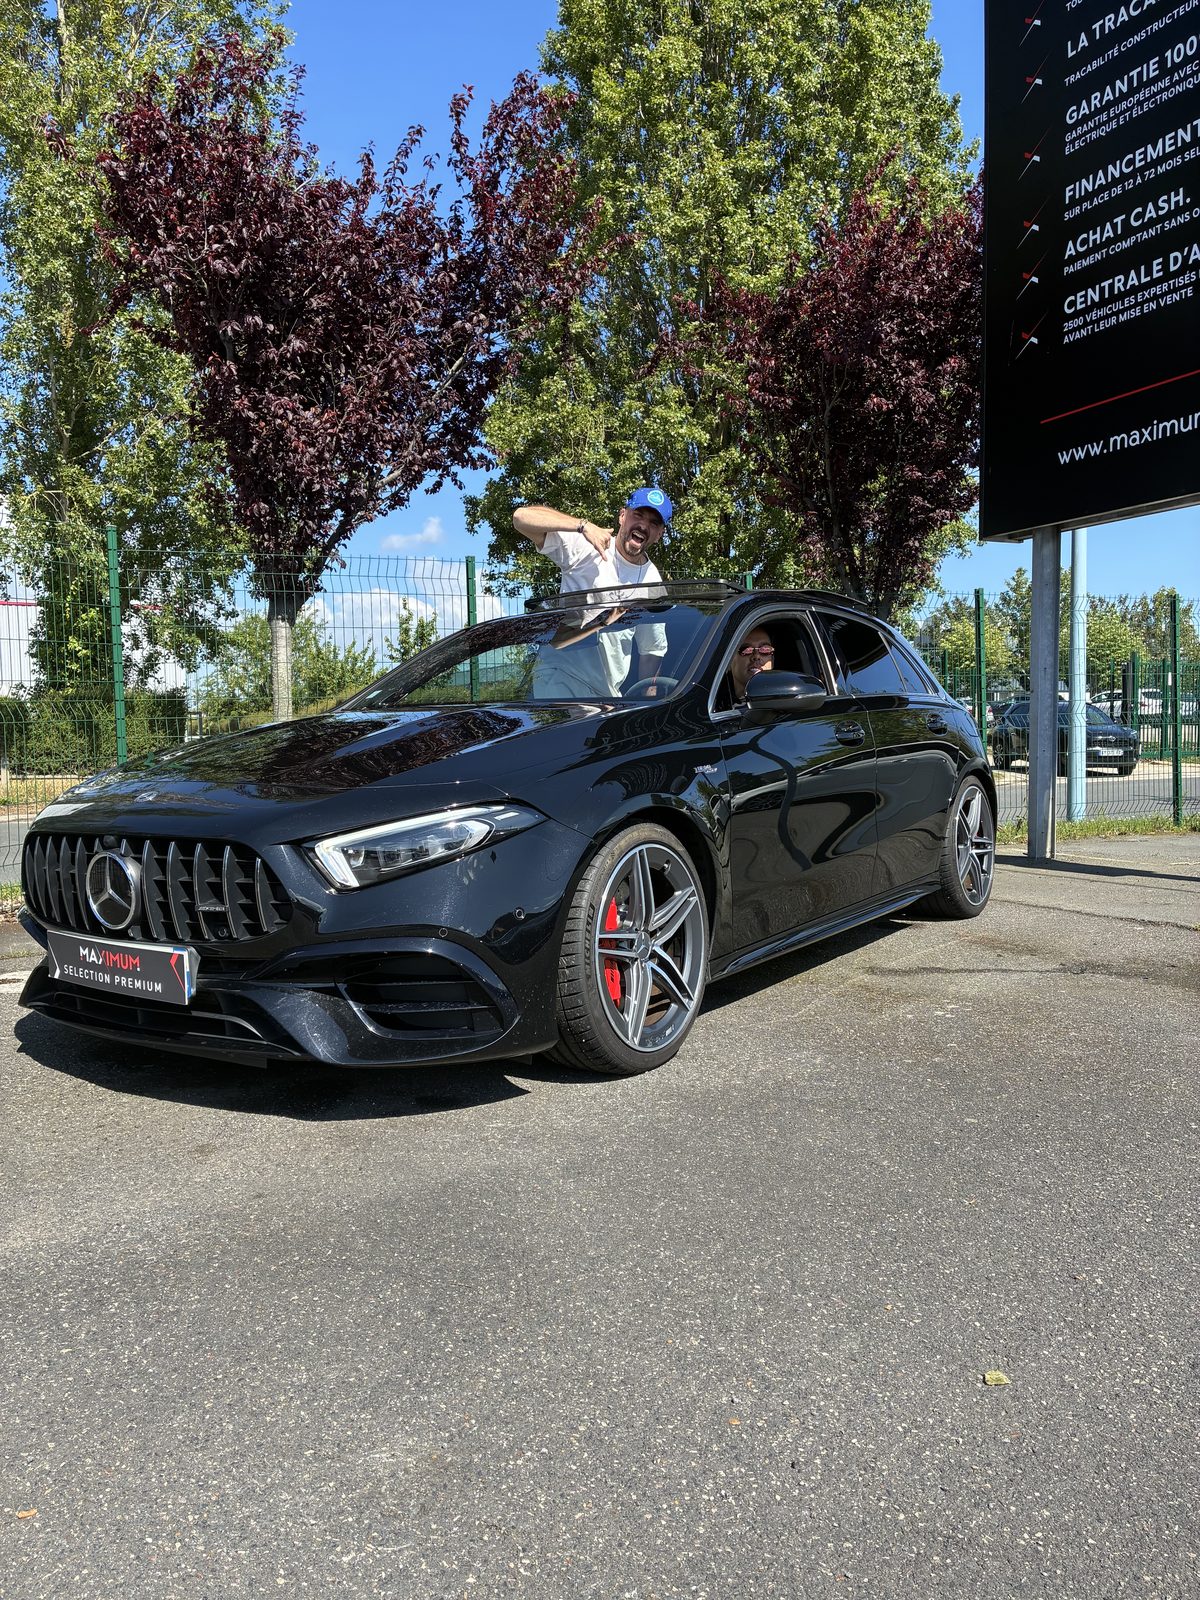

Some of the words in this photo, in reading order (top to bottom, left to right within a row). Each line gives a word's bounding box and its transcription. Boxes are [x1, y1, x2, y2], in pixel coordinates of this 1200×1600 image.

[1064, 43, 1119, 87] TRACABILITÉ
[1120, 0, 1199, 52] CONSTRUCTEUR
[1067, 31, 1089, 59] LA
[1091, 0, 1161, 40] TRACA
[1064, 110, 1108, 143] GARANTIE
[1109, 75, 1171, 118] EUROPÉENNE
[1172, 59, 1200, 83] AVEC
[1065, 56, 1160, 125] GARANTIE
[1164, 35, 1200, 69] 100
[1064, 118, 1118, 156] ÉLECTRIQUE
[1119, 110, 1131, 126] ET
[1065, 118, 1200, 205] FINANCEMENT
[1063, 205, 1081, 221] SUR
[1082, 190, 1110, 212] PLACE
[1111, 183, 1123, 198] DE
[1124, 178, 1134, 191] 12
[1135, 171, 1142, 186] À
[1143, 168, 1156, 182] 72
[1157, 154, 1183, 175] MOIS
[1063, 247, 1108, 276] PAIEMENT
[1108, 223, 1163, 255] COMPTANT
[1163, 211, 1191, 231] SANS
[1064, 214, 1126, 260] ACHAT
[1130, 187, 1191, 227] CASH.
[1063, 257, 1164, 315] CENTRALE
[1063, 316, 1084, 332] 2500
[1085, 295, 1136, 323] VÉHICULES
[1137, 270, 1197, 303] EXPERTISÉS
[1063, 324, 1093, 345] AVANT
[1094, 315, 1117, 333] LEUR
[1118, 305, 1142, 323] MISE
[1143, 300, 1157, 314] EN
[1158, 286, 1194, 307] VENTE
[63, 964, 110, 984] SELECTION
[114, 975, 162, 993] PREMIUM
[79, 945, 141, 972] MAXIMUM
